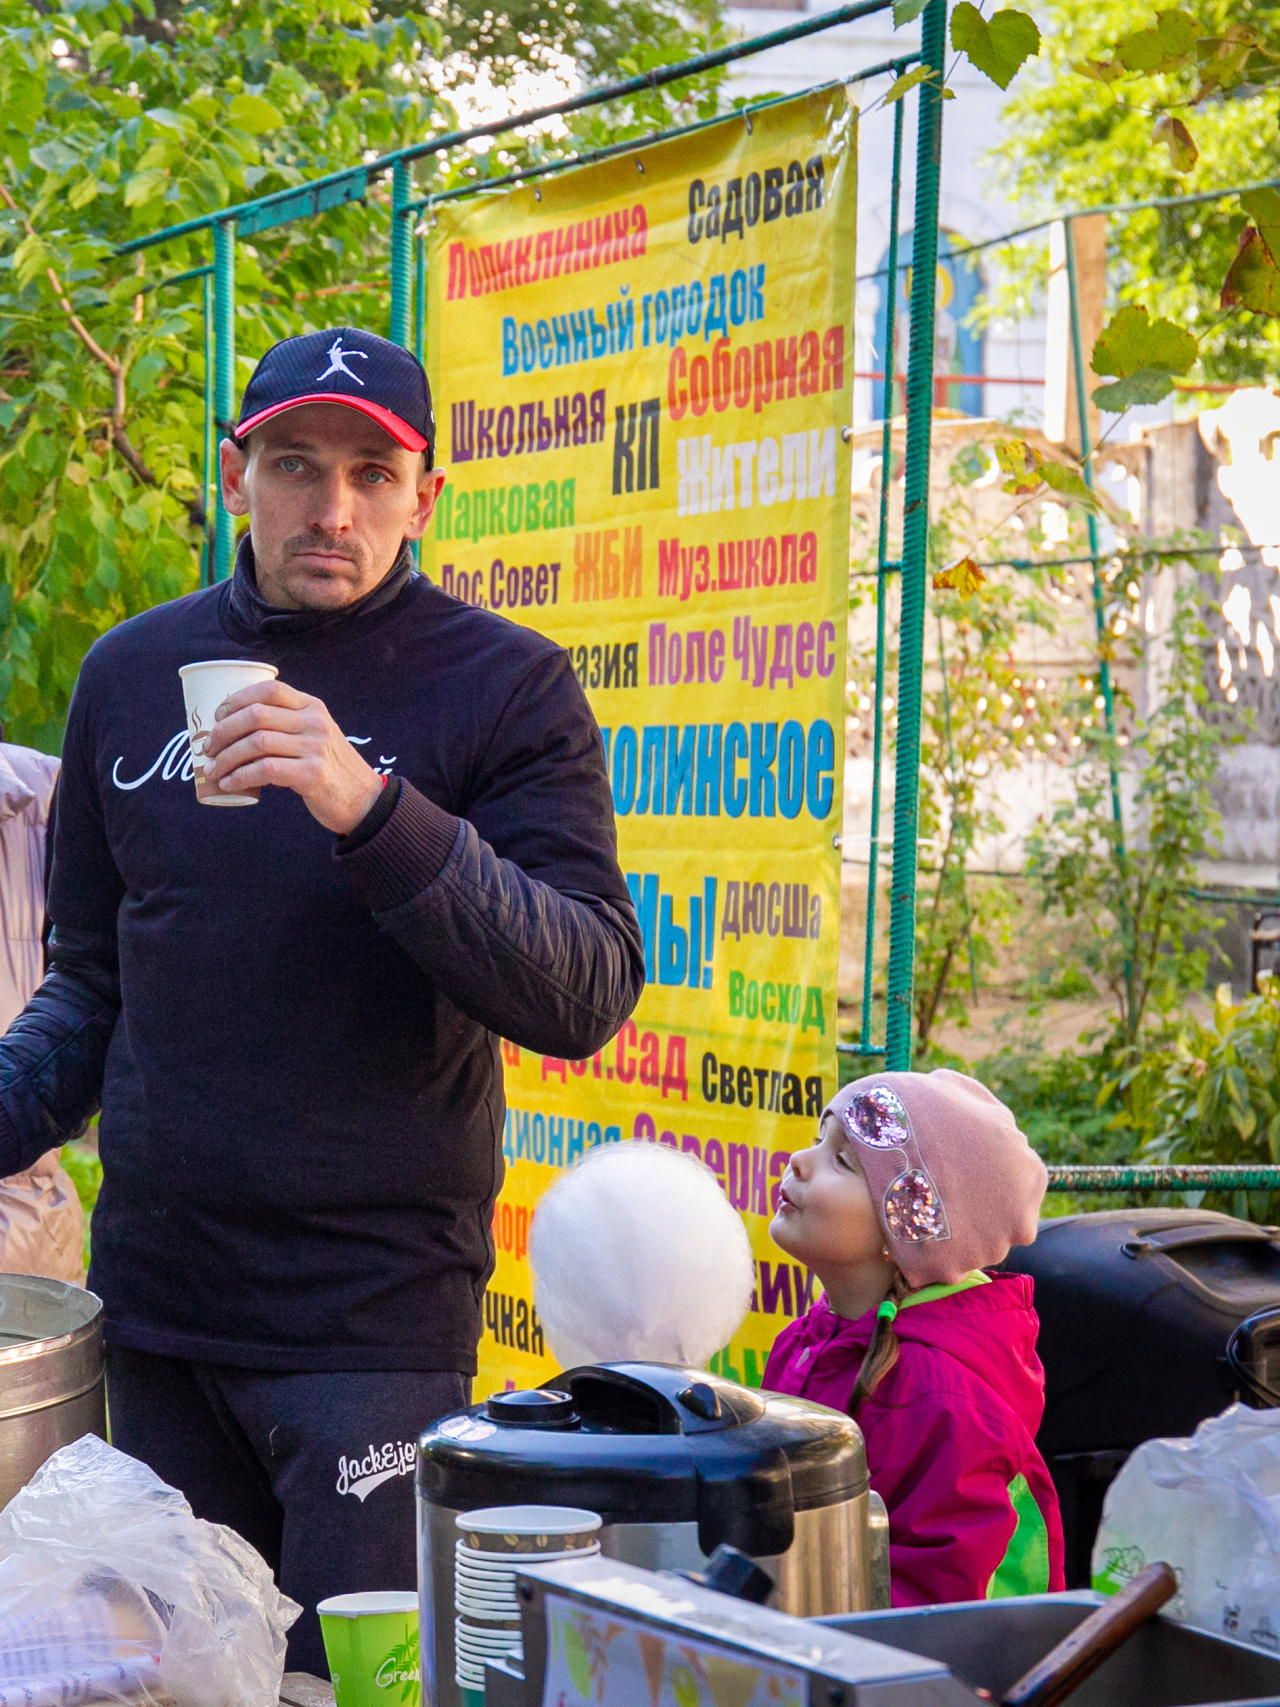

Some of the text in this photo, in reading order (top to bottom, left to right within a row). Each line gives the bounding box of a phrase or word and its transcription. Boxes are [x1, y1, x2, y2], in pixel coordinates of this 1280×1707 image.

[688, 155, 825, 244] Садовая
[446, 204, 648, 301] Поликлиника
[501, 263, 766, 377] Военный городок
[667, 325, 845, 421] Соборная
[451, 388, 606, 464] Школьная
[612, 397, 661, 495] КП
[434, 477, 576, 544] Парковая
[676, 427, 836, 517] Жители
[573, 526, 643, 603] ЖБИ
[657, 531, 818, 601] Муз.школа
[567, 642, 640, 690] азия
[648, 615, 836, 691] Поле Чудес
[600, 718, 836, 821] олинское
[729, 970, 825, 1036] Восход
[701, 1051, 824, 1118] Светлая
